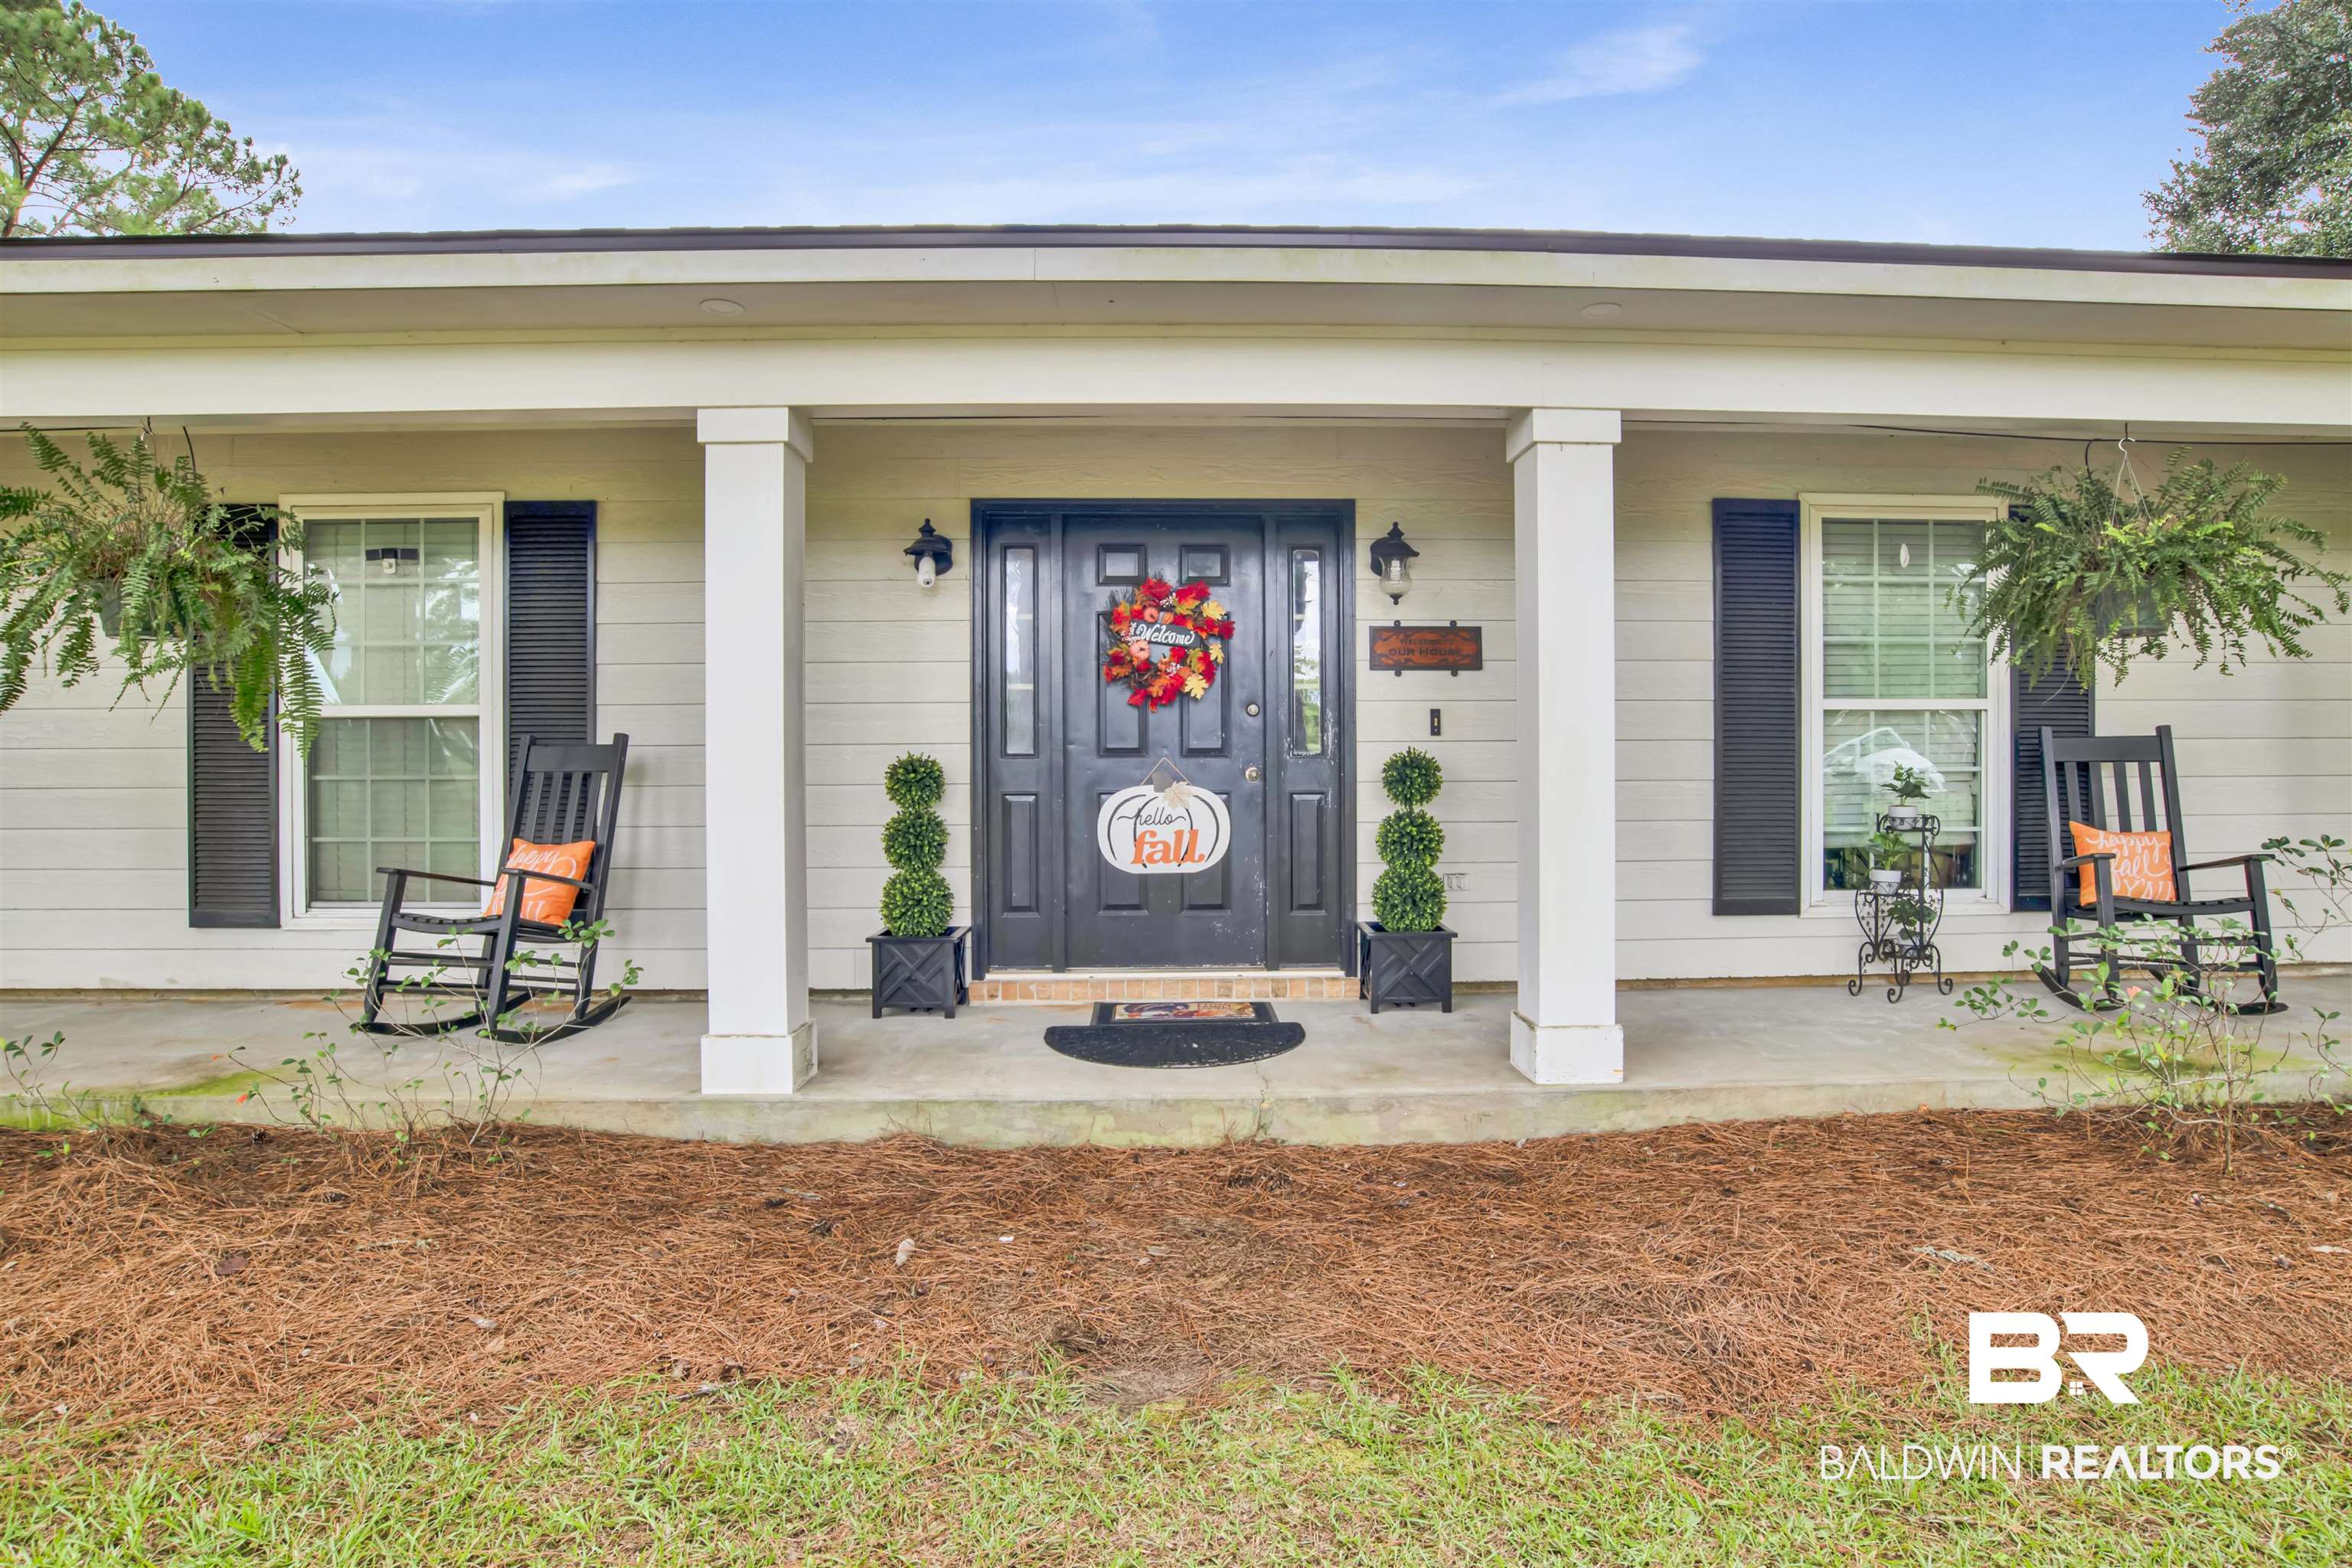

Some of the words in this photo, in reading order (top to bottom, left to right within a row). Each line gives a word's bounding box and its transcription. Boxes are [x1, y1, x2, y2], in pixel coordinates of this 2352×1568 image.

[1135, 623, 1195, 645] Welcome
[1117, 807, 1187, 825] hello
[1130, 829, 1206, 864] fall
[2086, 830, 2170, 864] happy
[2111, 848, 2168, 891] fall
